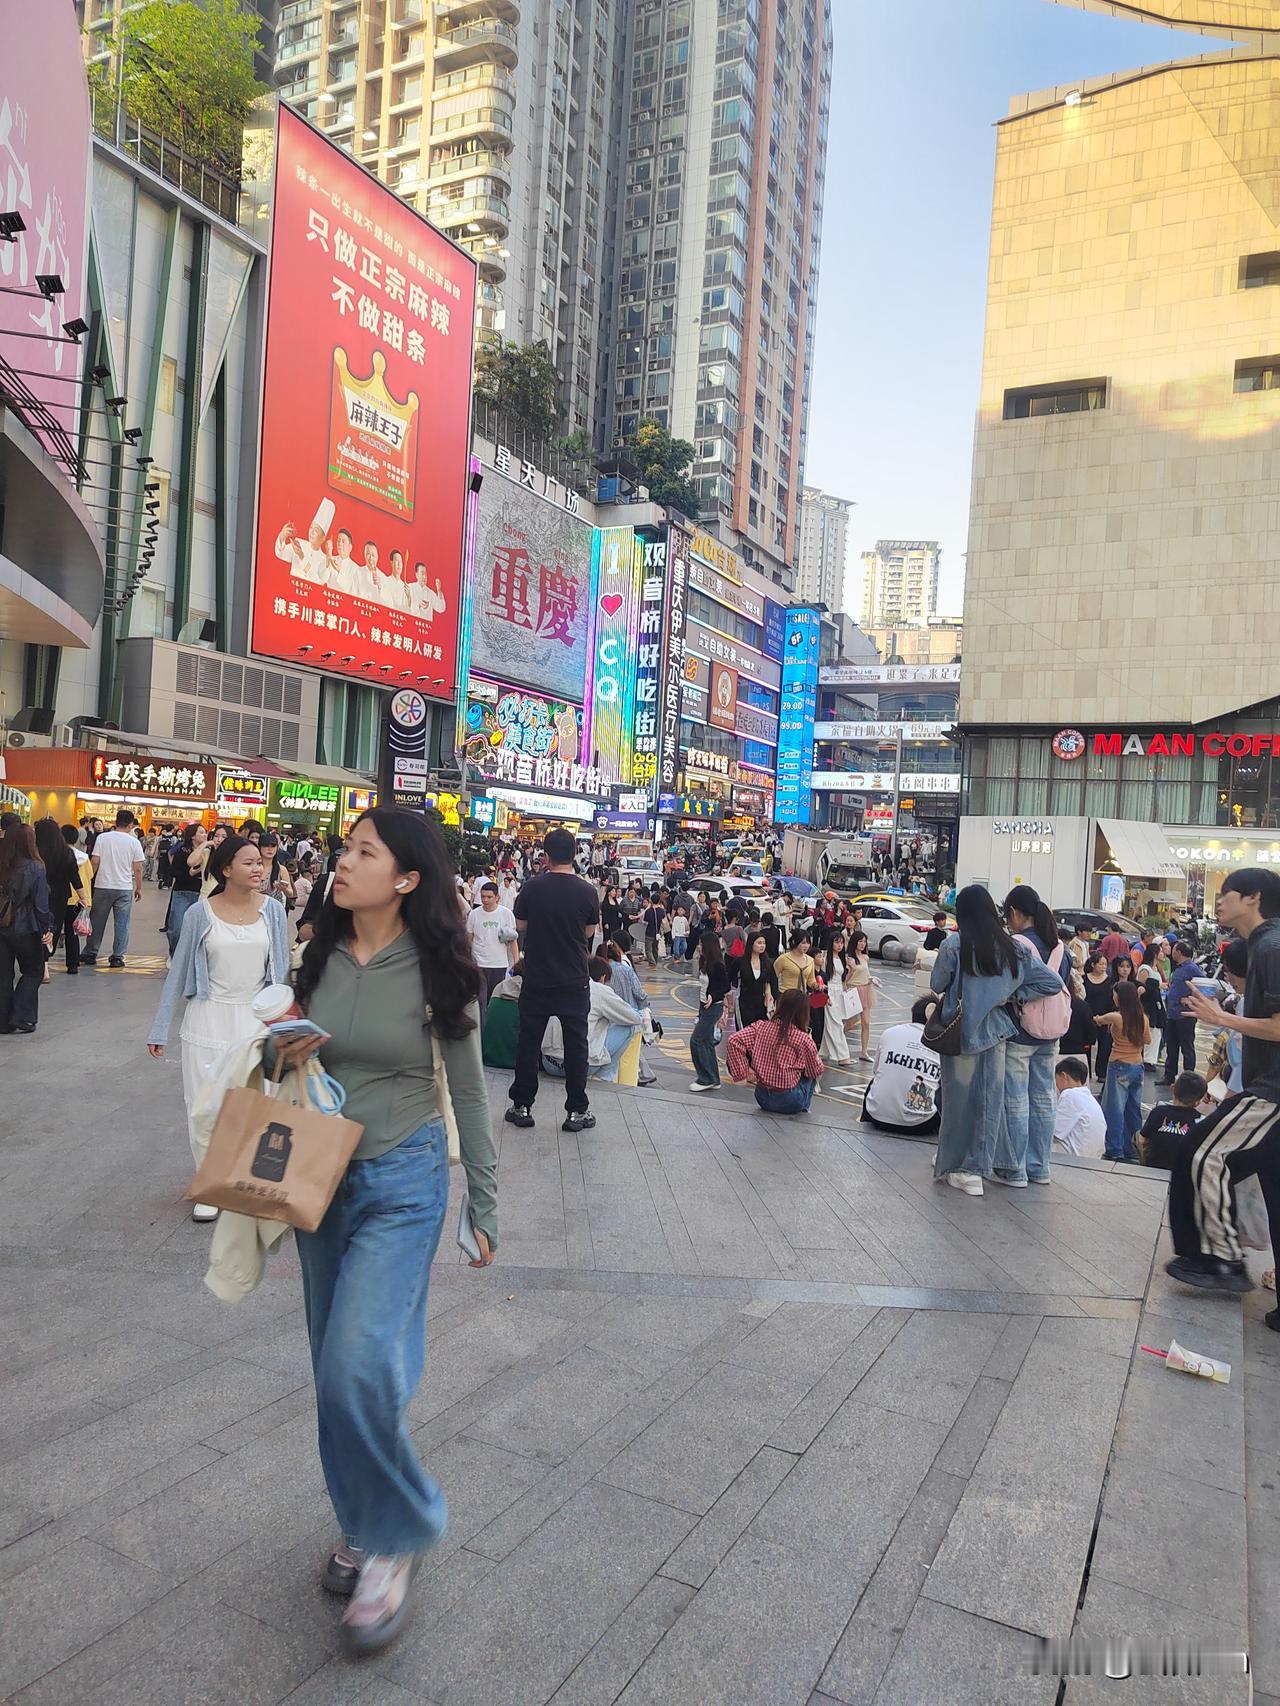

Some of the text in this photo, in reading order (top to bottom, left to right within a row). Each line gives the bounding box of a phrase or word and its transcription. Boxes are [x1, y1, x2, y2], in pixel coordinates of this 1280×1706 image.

[306, 207, 450, 337] 只做正宗麻辣
[331, 275, 427, 367] 不做甜条
[350, 400, 403, 446] 麻辣王子
[493, 444, 580, 515] 星天广场
[273, 596, 443, 662] 携手川菜掌门人、辣条发明人研发
[635, 542, 666, 736] 观音桥好吃街
[782, 702, 803, 711] 29.00
[505, 723, 554, 753] 美食街
[781, 721, 802, 731] 99.00
[1093, 733, 1195, 756] MAAN
[96, 779, 203, 796] HUANG SHANSHAN
[105, 759, 206, 790] 重庆手撕烤兔
[496, 750, 600, 797] 观音桥好吃街
[628, 800, 645, 810] 入口
[993, 820, 1055, 836] SANCHA
